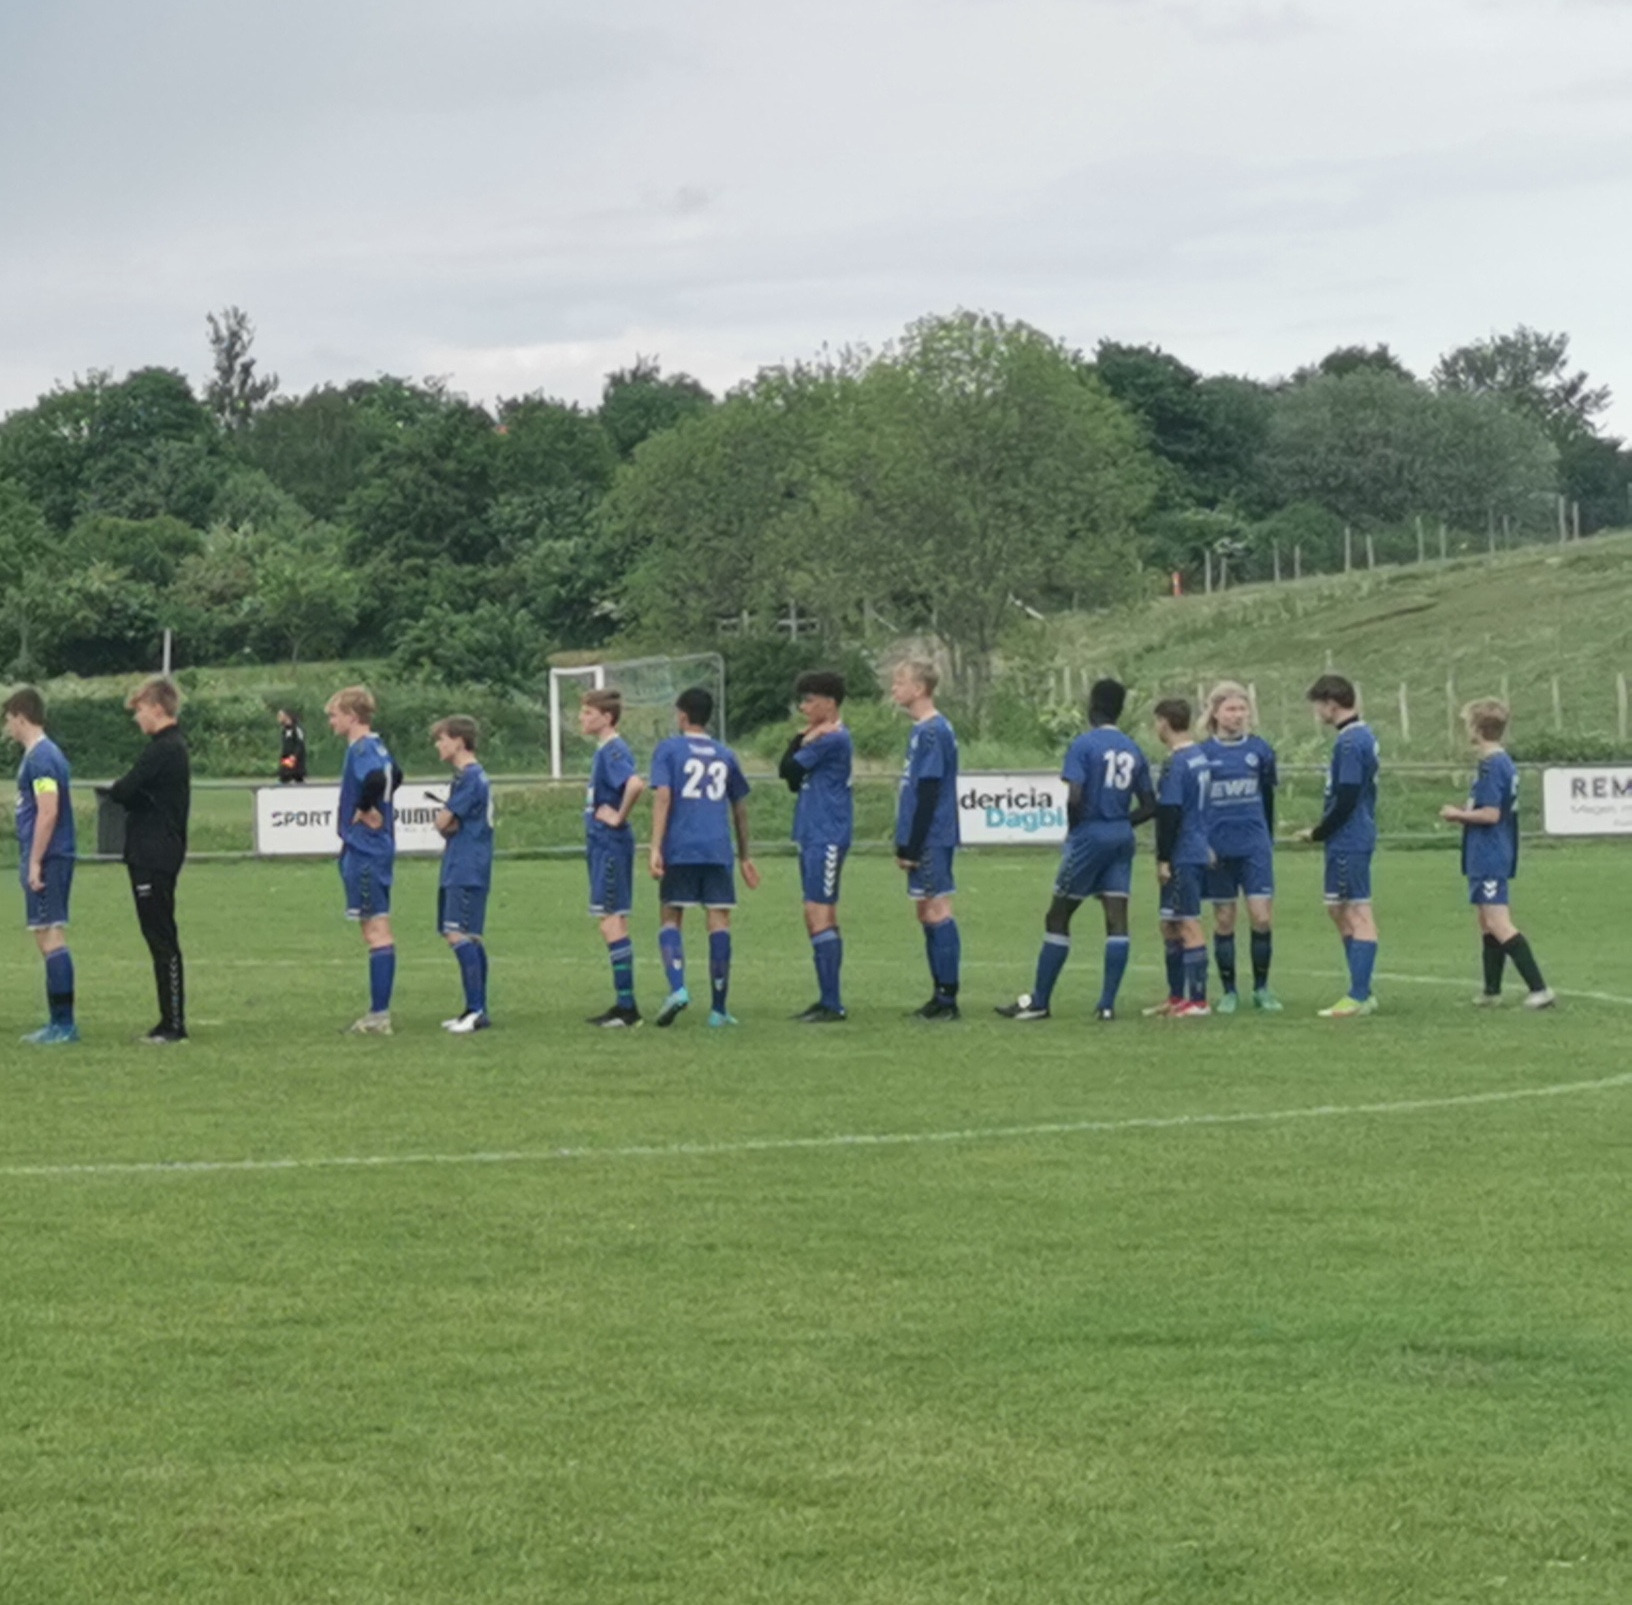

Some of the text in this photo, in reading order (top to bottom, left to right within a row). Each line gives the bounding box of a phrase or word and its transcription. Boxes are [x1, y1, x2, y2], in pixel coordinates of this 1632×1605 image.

[681, 757, 729, 801] 23
[1103, 750, 1136, 791] 13
[271, 811, 333, 828] SPORT
